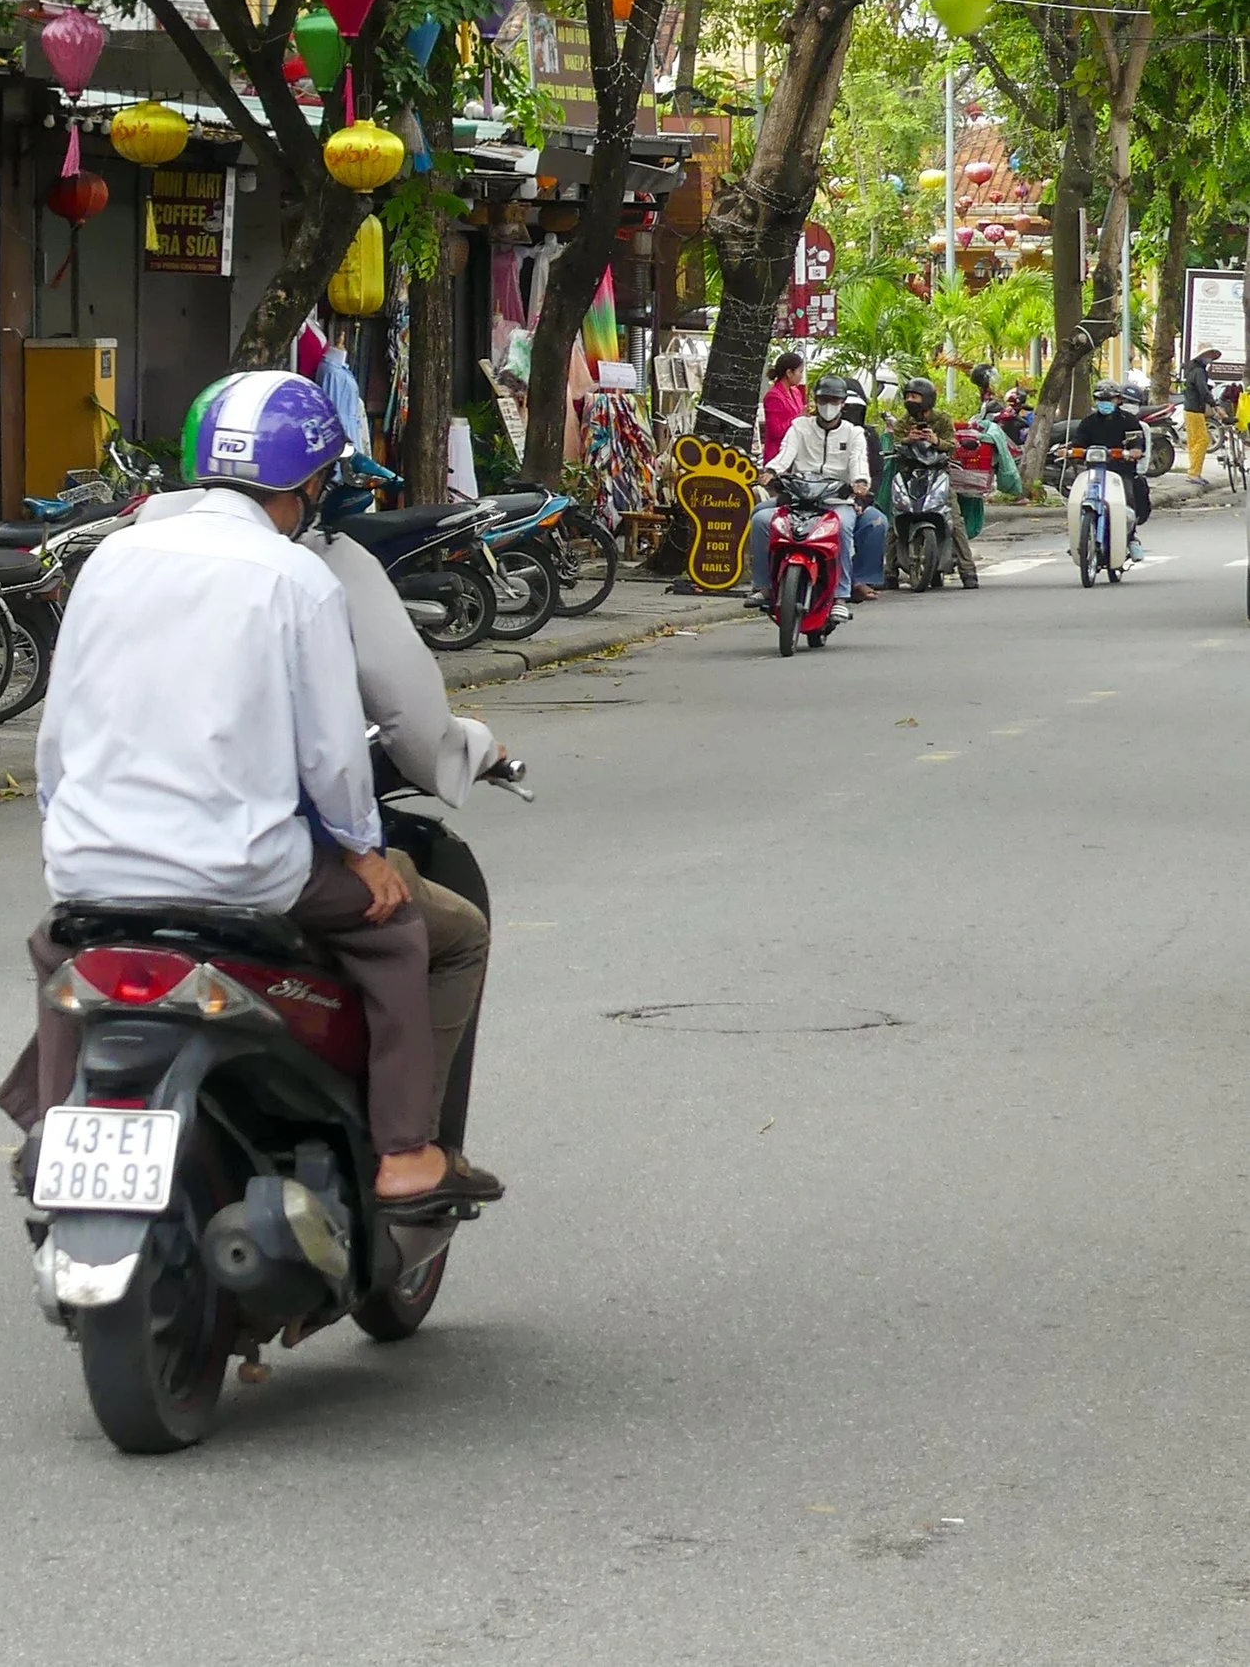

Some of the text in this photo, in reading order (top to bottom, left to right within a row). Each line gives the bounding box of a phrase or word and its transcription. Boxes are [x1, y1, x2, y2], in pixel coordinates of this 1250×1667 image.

[153, 171, 222, 199] MINI MART
[154, 203, 207, 226] COFFEE
[707, 521, 732, 531] BODY
[706, 542, 730, 551] FOOT
[701, 563, 730, 572] NAILS
[46, 1160, 161, 1201] 386.93
